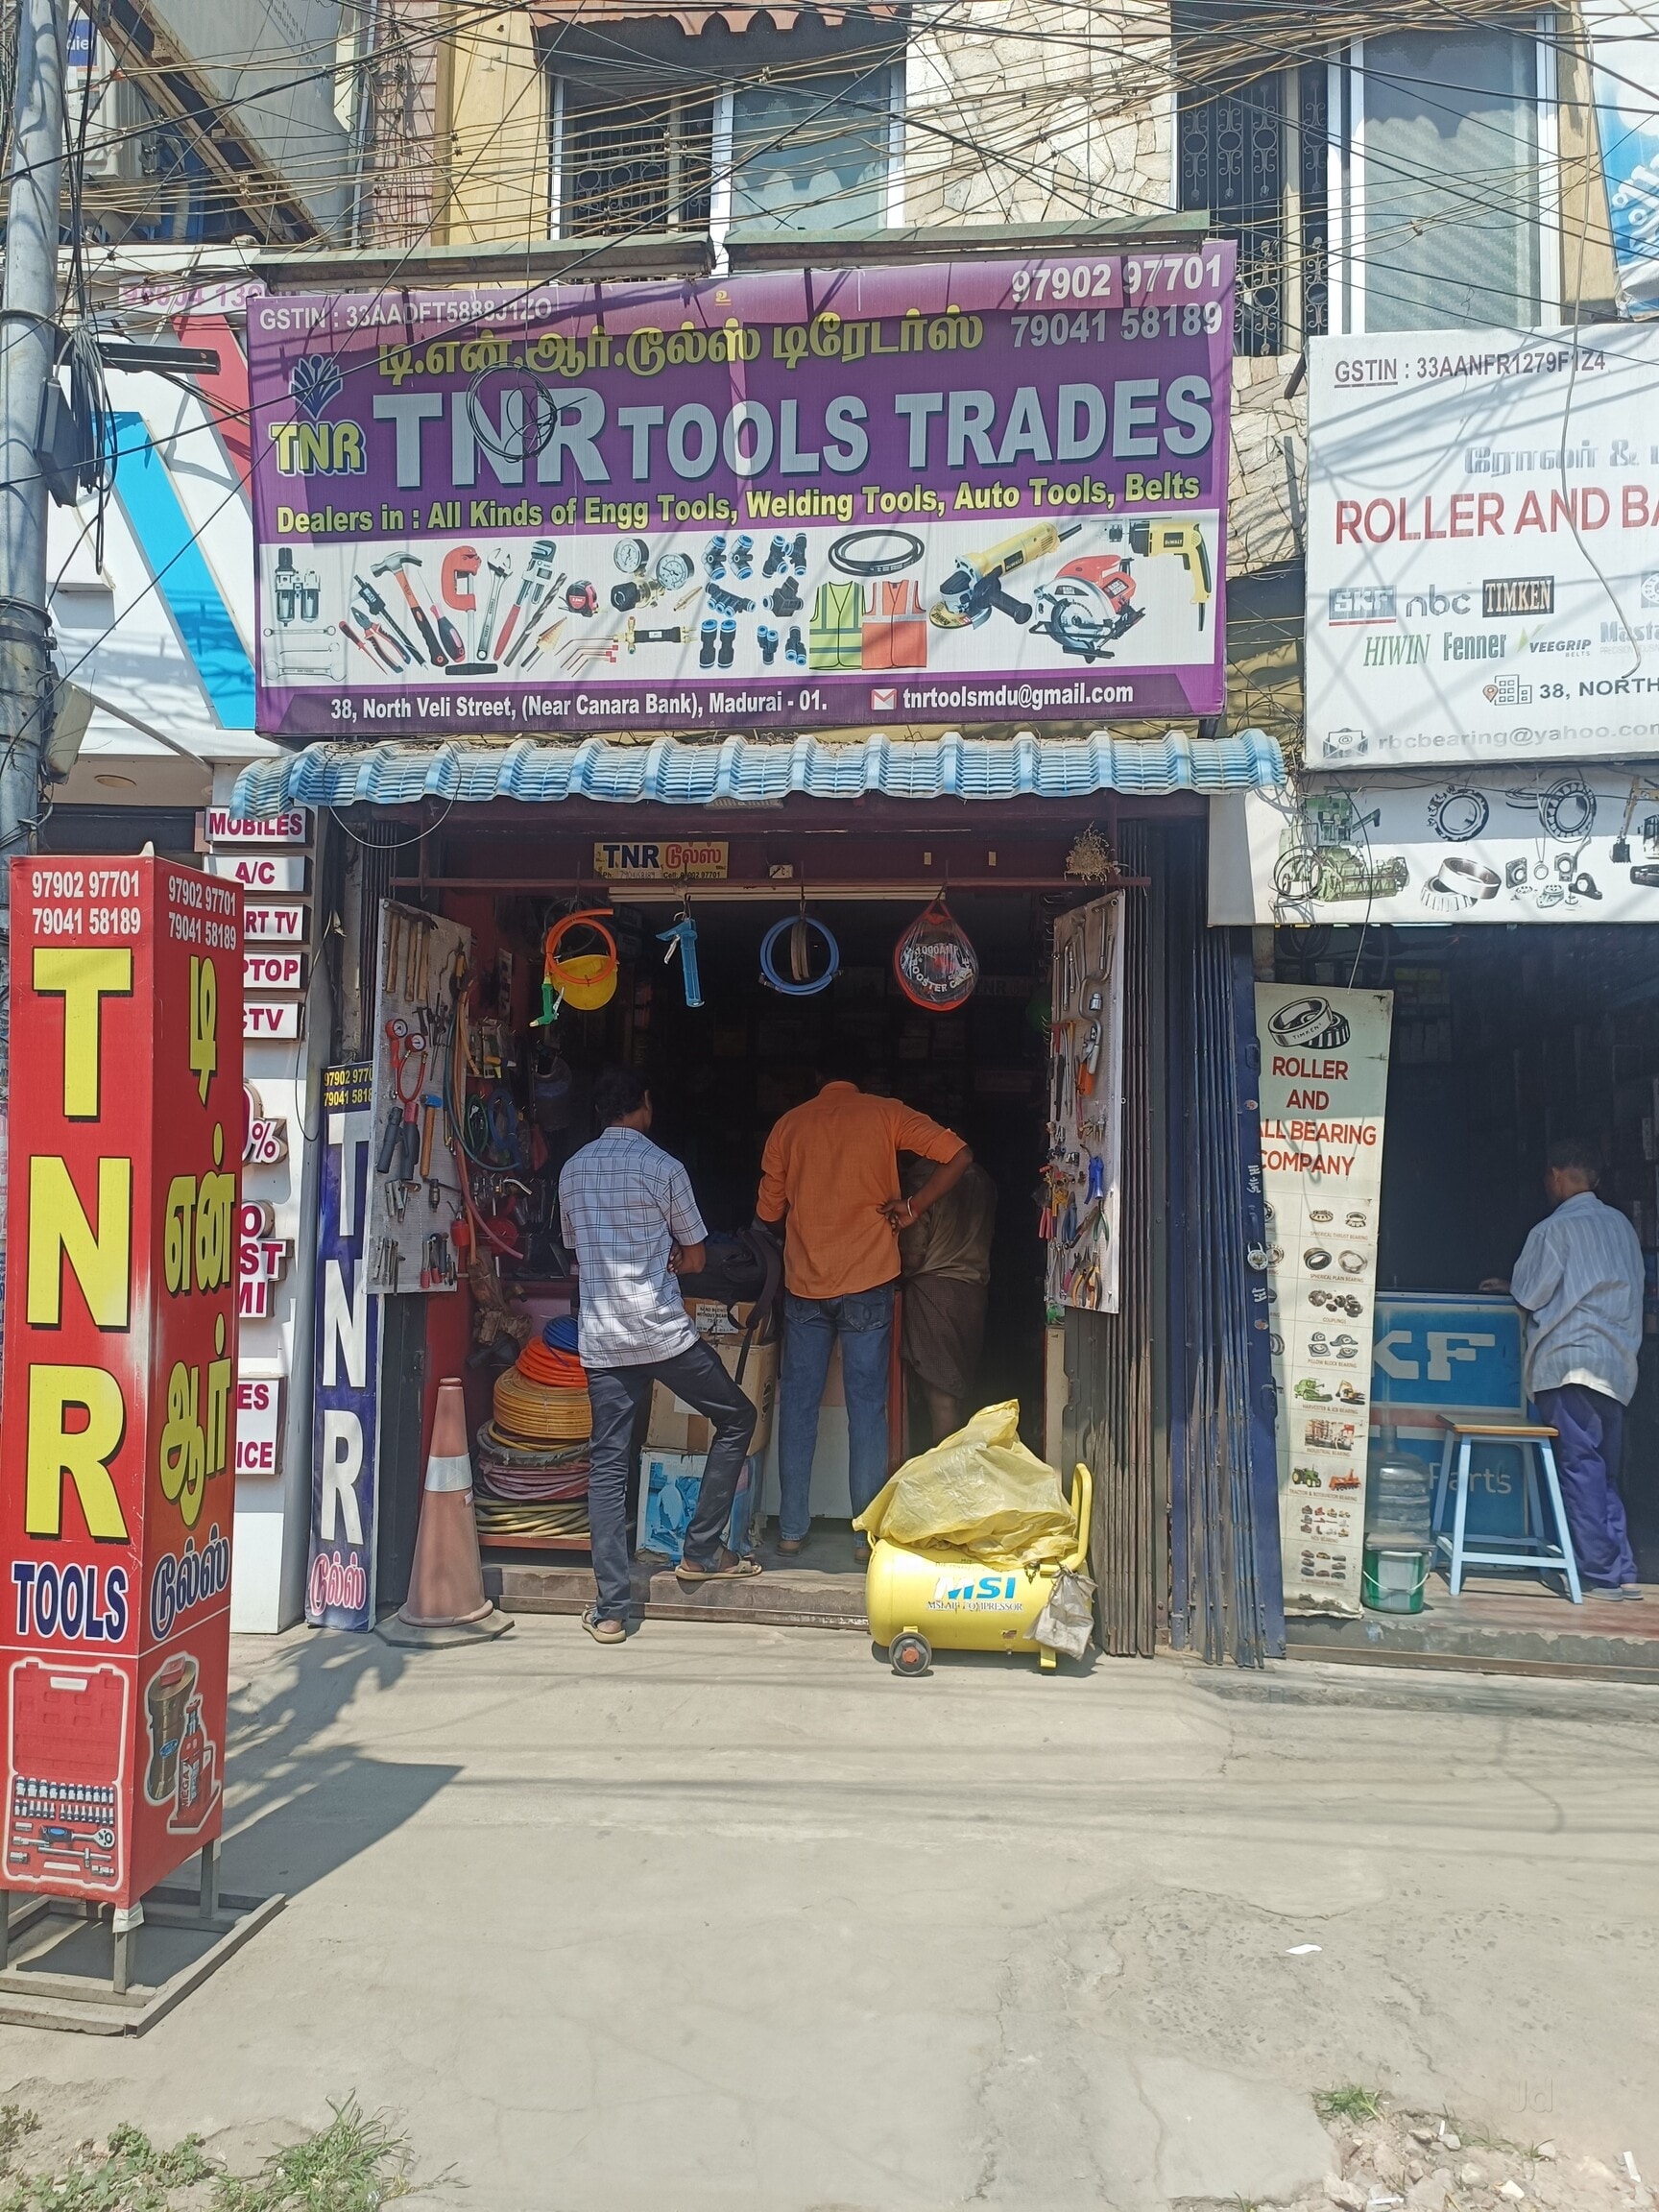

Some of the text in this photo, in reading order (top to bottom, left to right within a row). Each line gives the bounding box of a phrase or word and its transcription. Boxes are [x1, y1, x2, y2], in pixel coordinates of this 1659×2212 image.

[1011, 254, 1221, 302] 97902 97701
[259, 308, 326, 330] GSTIN
[1011, 301, 1222, 348] 79041 58189
[1334, 358, 1398, 384] GSTIN
[373, 375, 1214, 489] TNR TOOLS TRADES
[270, 421, 367, 476] TNR
[277, 505, 373, 534] Dealers
[380, 502, 404, 530] in
[428, 500, 462, 528] All
[470, 497, 543, 526] Kinds
[551, 496, 578, 523] of
[585, 494, 650, 529] Engg
[658, 493, 738, 525] Tools,
[746, 487, 854, 522] Welding
[861, 484, 947, 517] Tools,
[953, 481, 1022, 510] Auto
[1029, 476, 1116, 509] Tools,
[1125, 470, 1199, 501] Belts
[1335, 485, 1659, 545] ROLLER AND B
[1334, 589, 1394, 613] SKF
[1406, 584, 1472, 617] nbc
[1484, 579, 1552, 613] TIMKEN
[1362, 634, 1431, 667] HIWIN
[1443, 632, 1507, 662] Fenner
[1528, 638, 1592, 655] VEEGRIP
[902, 684, 1134, 710] tnrtoolsmdu@gmail.com
[1539, 677, 1659, 701] 38, NORTH
[330, 699, 358, 723] 38,
[363, 697, 412, 719] North
[417, 696, 450, 717] Veli
[456, 693, 517, 718] Street,
[521, 694, 571, 721] (Near
[576, 692, 638, 715] Canara
[645, 690, 704, 718] Bank),
[709, 689, 783, 712] Madurai
[799, 688, 827, 710] 01.
[208, 813, 302, 836] MOBILES
[603, 844, 661, 869] TNR
[32, 870, 140, 899] 97902 97701
[235, 861, 276, 884] A/C
[168, 875, 236, 917] 97902 97701
[32, 907, 141, 935] 79041 58189
[168, 911, 237, 950] 79041 58189
[275, 911, 299, 934] TV
[243, 1008, 284, 1031] TV
[1292, 1023, 1320, 1040] TIMKEN
[325, 1070, 350, 1086] 97902
[1272, 1057, 1349, 1080] ROLLER
[324, 1090, 349, 1107] 79041
[1286, 1089, 1330, 1111] AND
[1261, 1118, 1377, 1145] LL BEARING
[12, 1560, 129, 1642] TOOLS
[934, 1577, 1016, 1599] MSI
